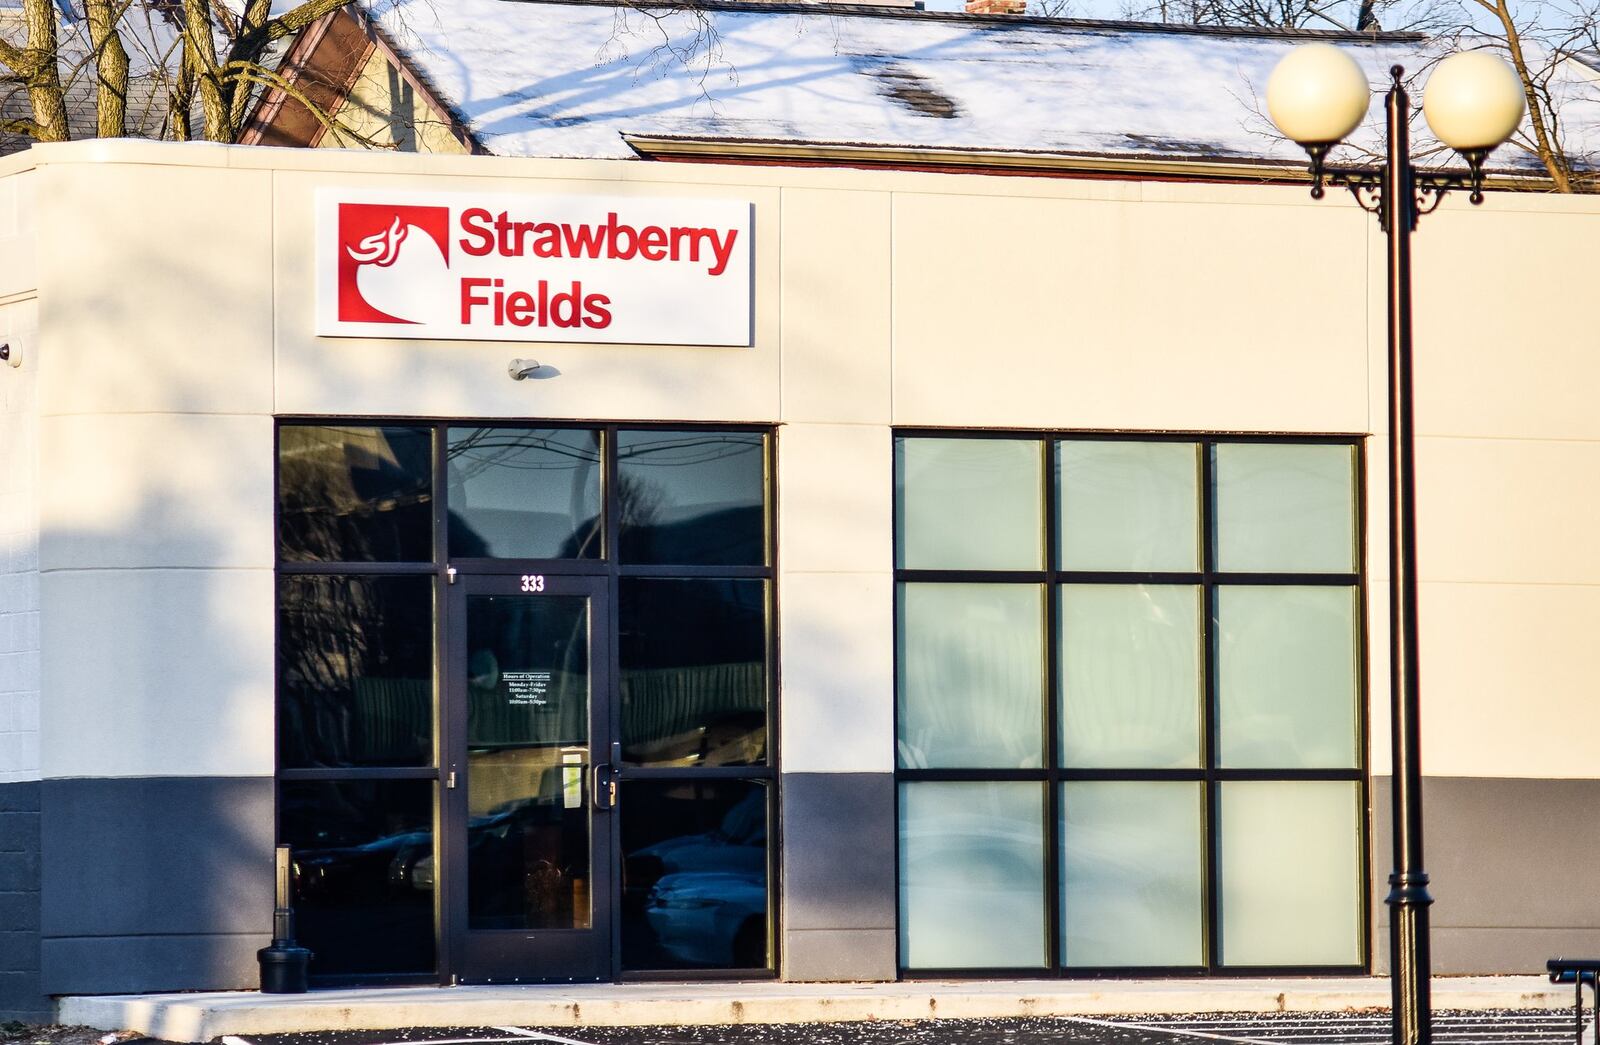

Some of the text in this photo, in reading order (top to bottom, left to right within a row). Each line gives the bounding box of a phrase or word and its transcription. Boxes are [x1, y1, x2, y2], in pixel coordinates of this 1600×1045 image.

[459, 207, 738, 276] Strawberry
[461, 278, 612, 329] Fields
[521, 575, 544, 592] 333
